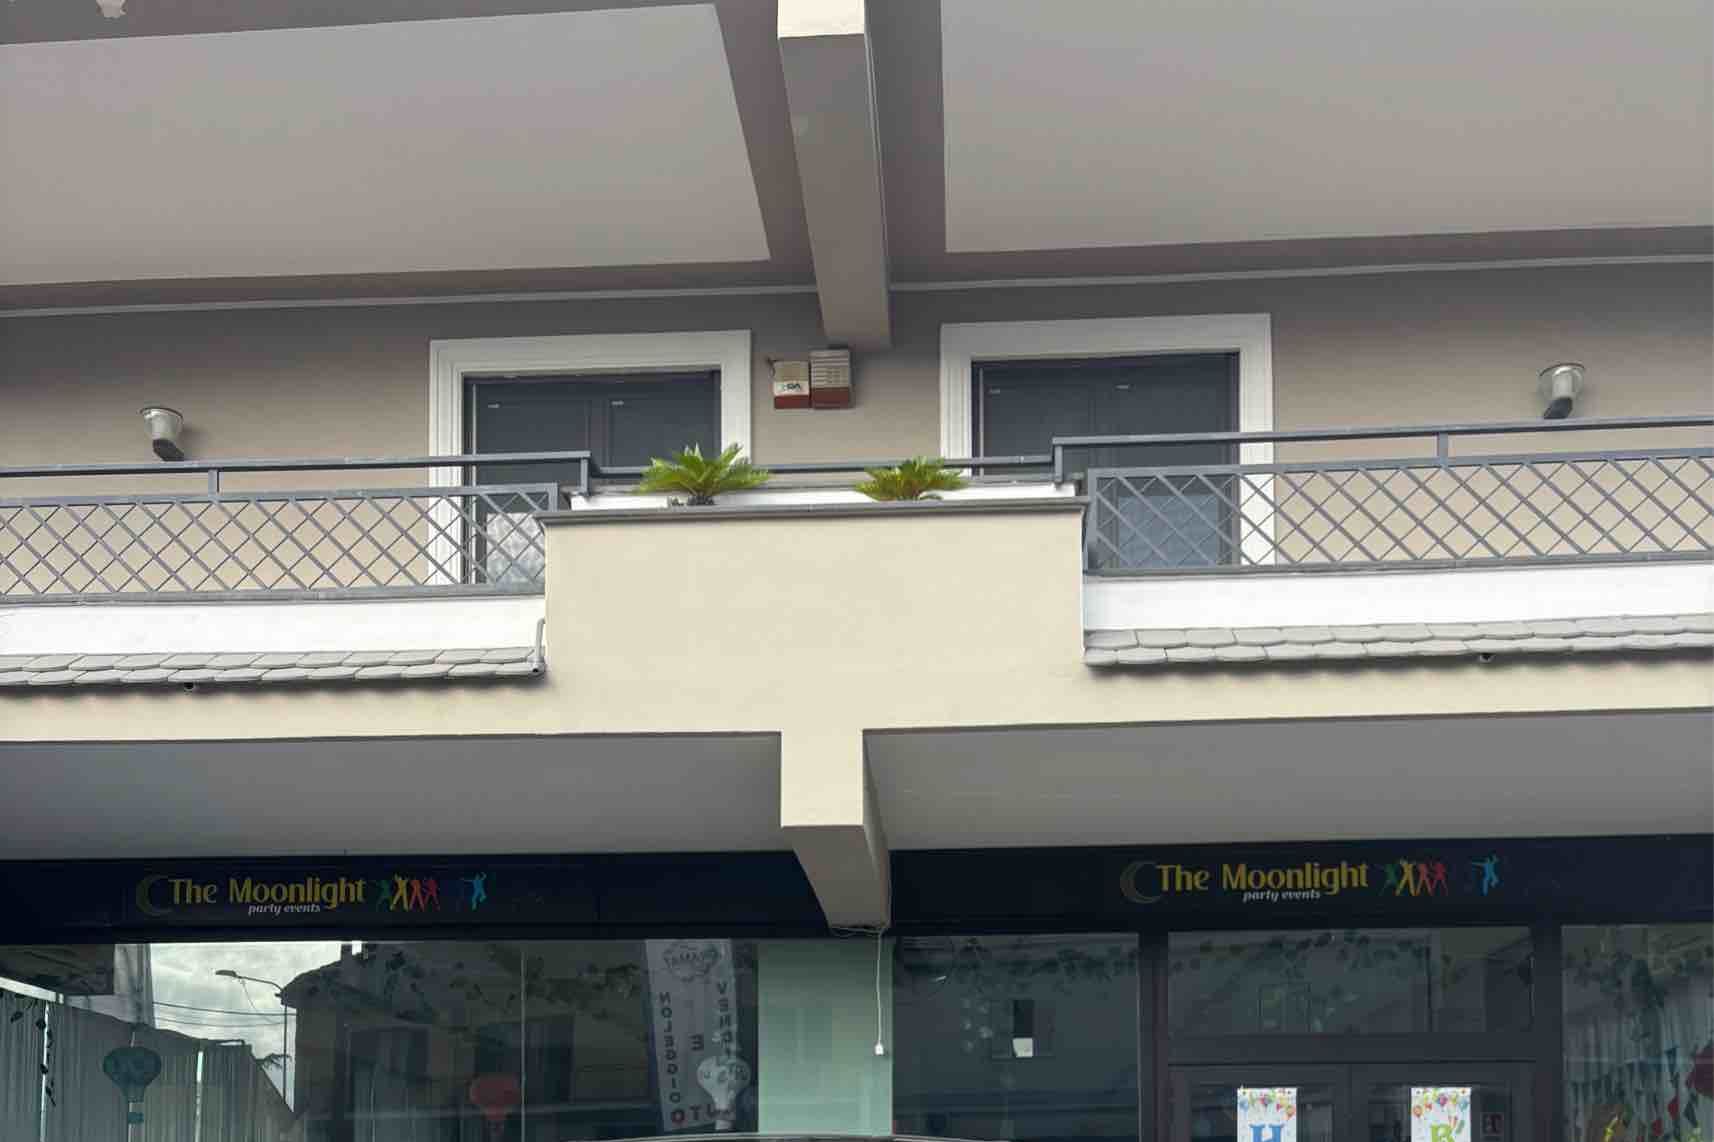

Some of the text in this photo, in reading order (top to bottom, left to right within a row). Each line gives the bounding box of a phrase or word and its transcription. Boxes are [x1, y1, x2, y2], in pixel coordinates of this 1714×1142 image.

[1156, 861, 1368, 895] The Moonlight
[168, 876, 366, 909] The Moonlight
[1243, 889, 1320, 902] party events
[248, 903, 321, 916] party events
